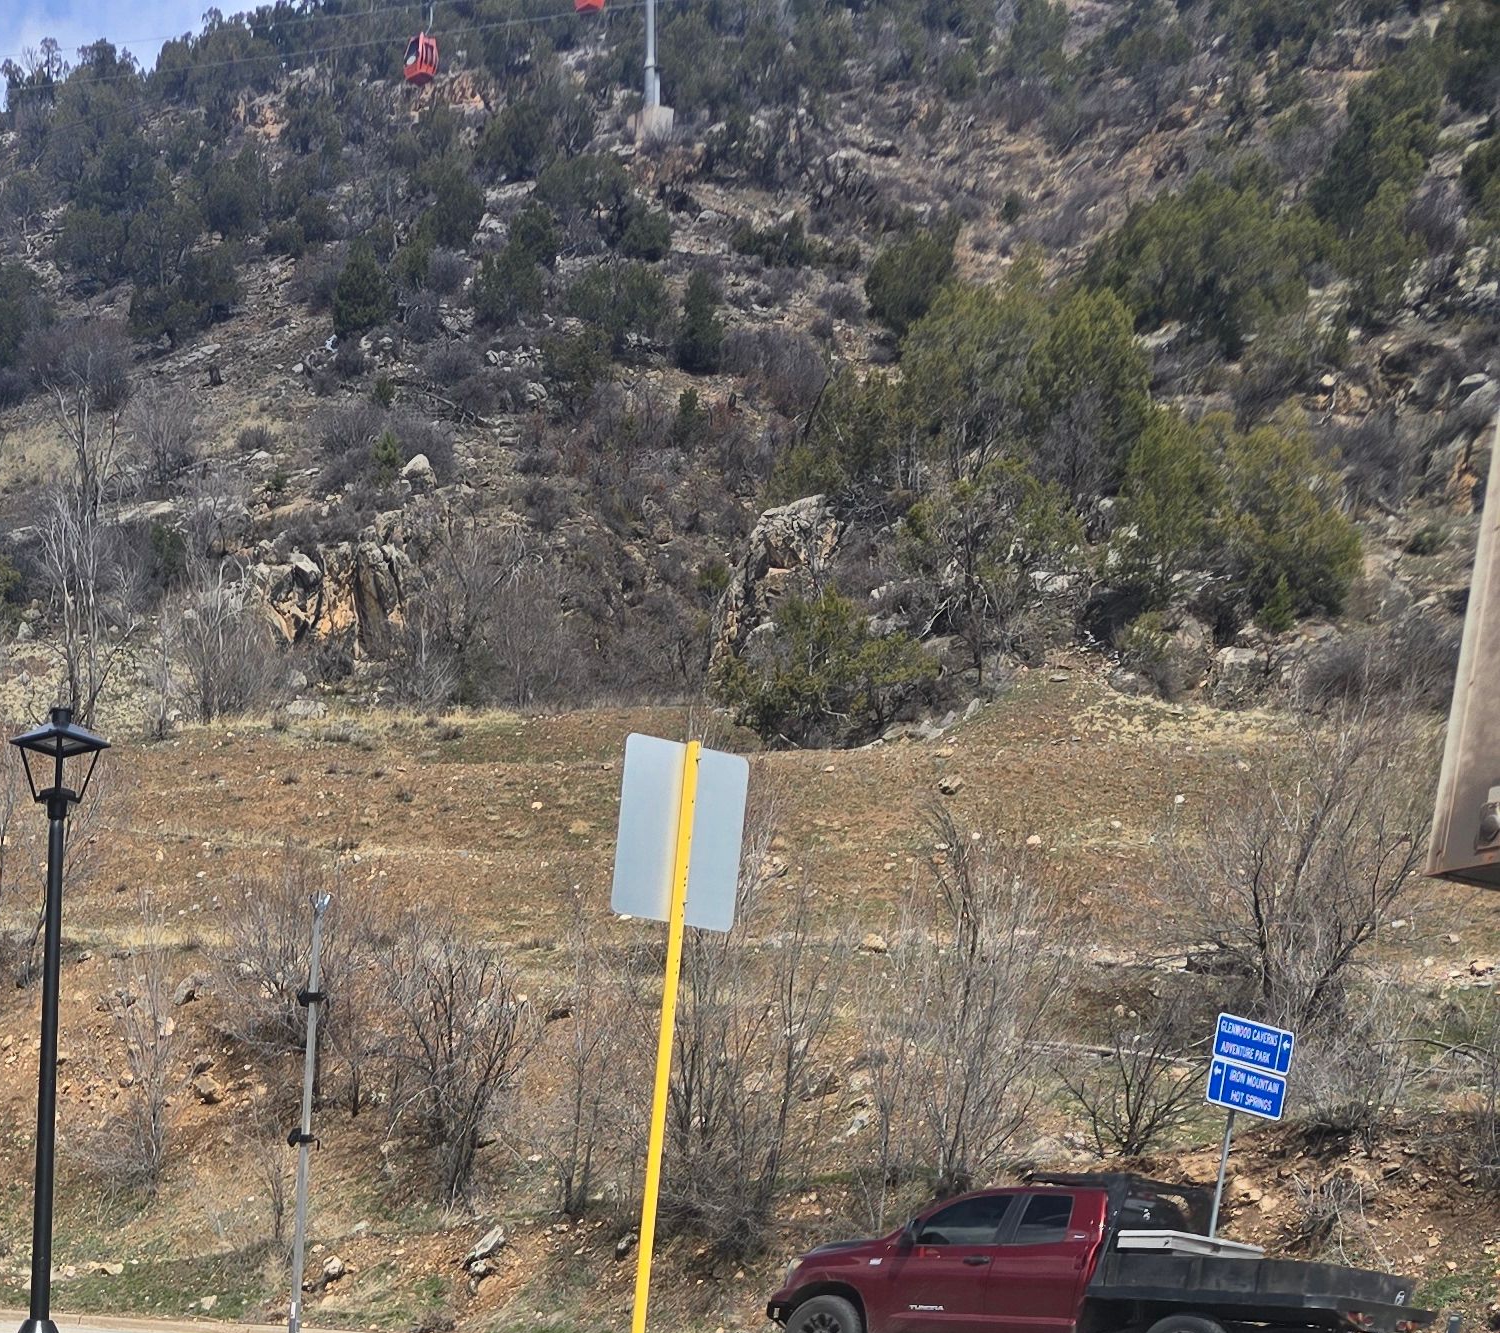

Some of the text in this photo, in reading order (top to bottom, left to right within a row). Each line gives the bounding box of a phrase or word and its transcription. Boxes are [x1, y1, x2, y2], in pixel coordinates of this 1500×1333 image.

[1220, 1020, 1278, 1047] GLENWOOD CAVERNS
[1220, 1041, 1271, 1064] ADVENTURE PARK
[1229, 1069, 1280, 1095] IRON MOUNTAIN
[1230, 1090, 1273, 1112] HOT SPRINGS
